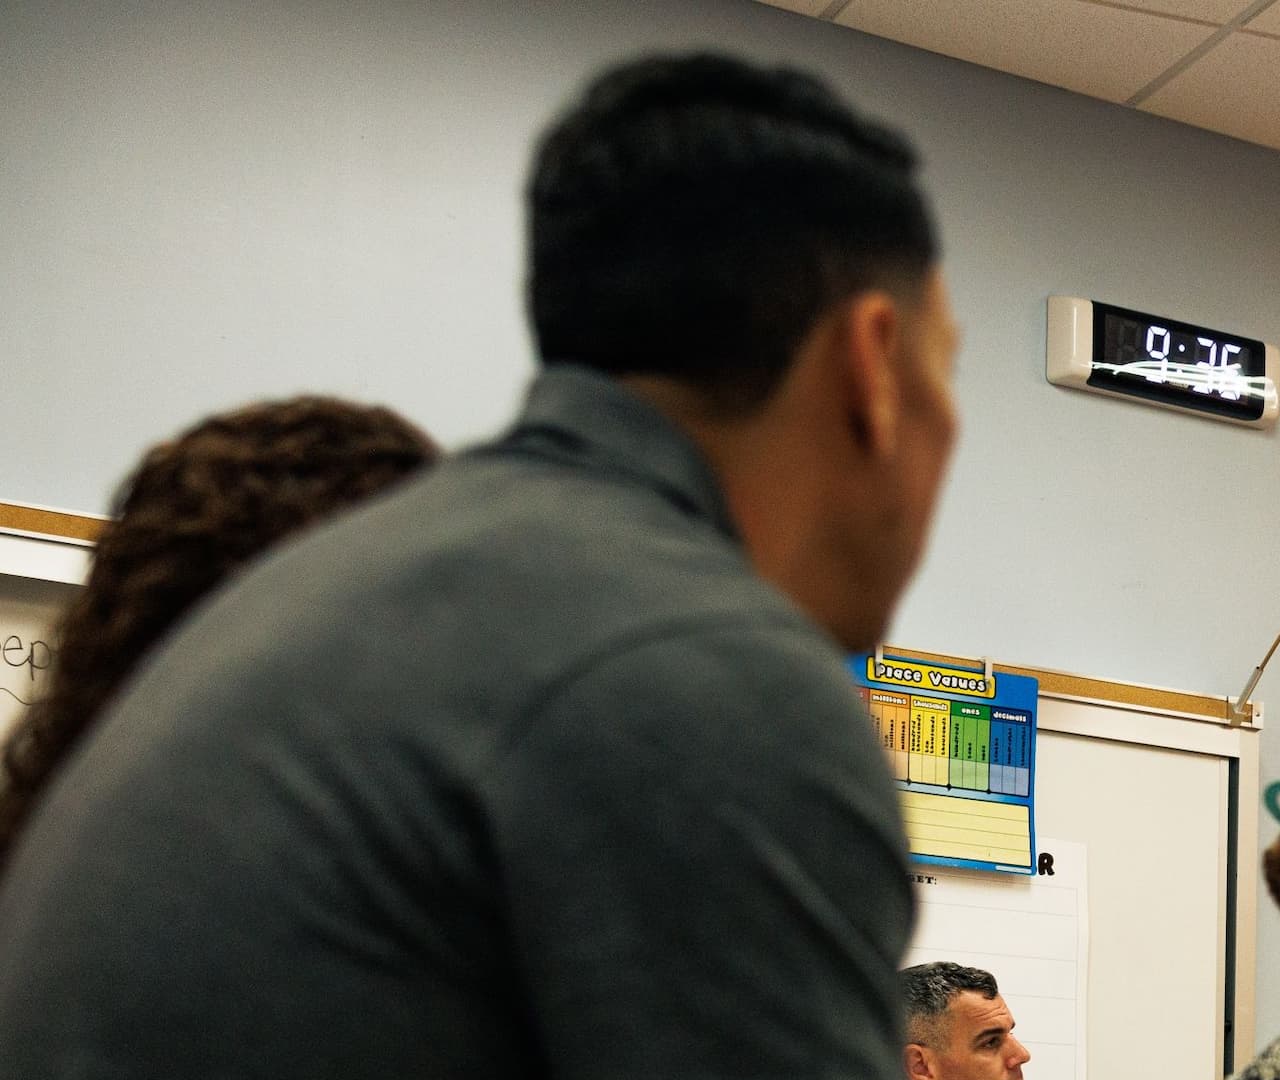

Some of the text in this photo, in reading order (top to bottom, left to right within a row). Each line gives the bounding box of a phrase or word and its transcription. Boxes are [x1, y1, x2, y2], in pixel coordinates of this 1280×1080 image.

[2, 635, 51, 681] ep
[875, 662, 988, 692] Place Values
[872, 694, 907, 705] millions
[992, 711, 1026, 722] decimals
[1038, 852, 1055, 876] R
